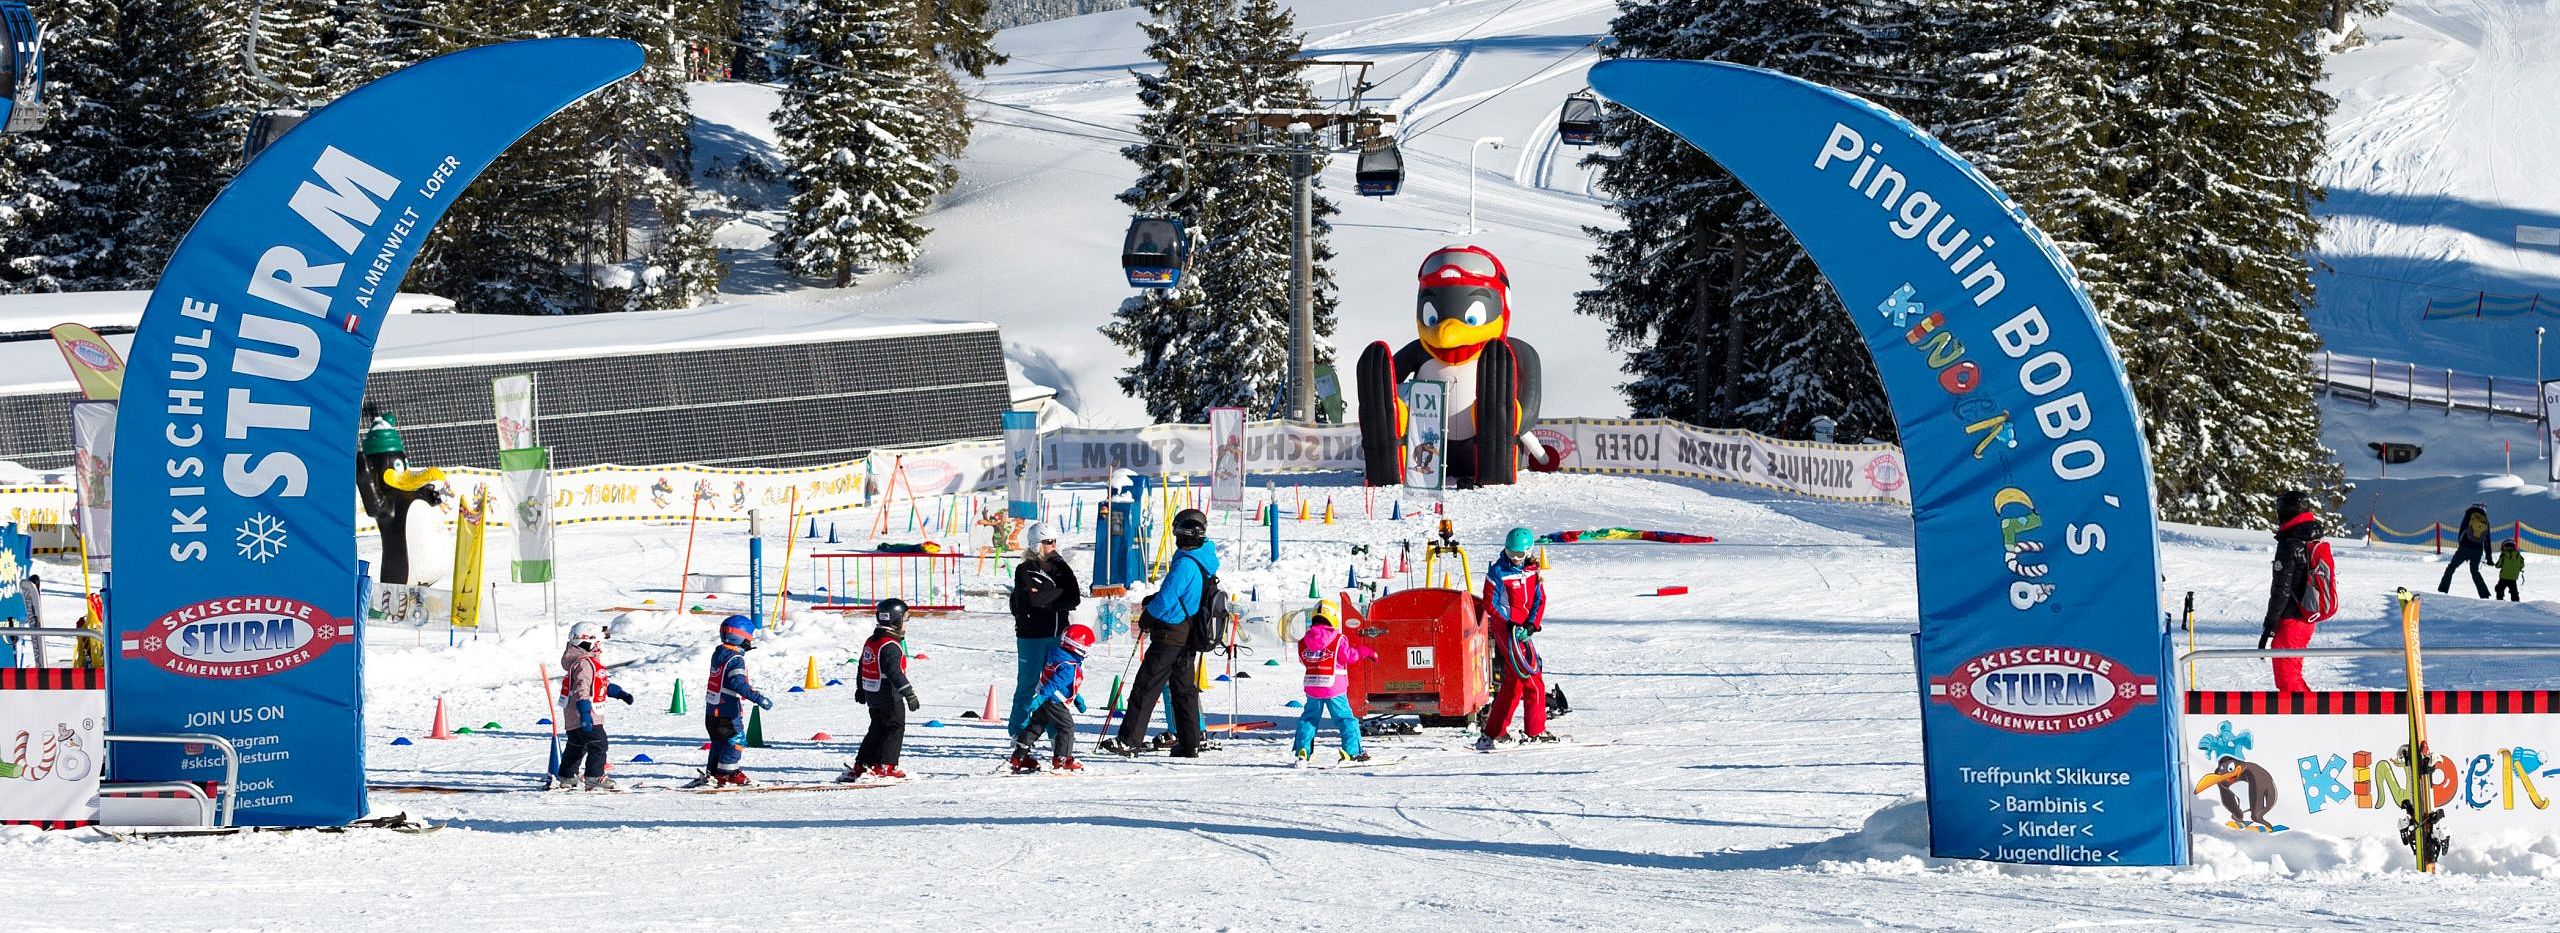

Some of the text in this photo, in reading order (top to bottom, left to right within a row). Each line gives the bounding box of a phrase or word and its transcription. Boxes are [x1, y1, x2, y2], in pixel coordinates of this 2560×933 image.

[1814, 122, 2007, 308] Pinguin
[355, 154, 461, 309] ALMENWELT LOFER
[223, 144, 402, 498] STURM
[165, 296, 219, 562] SKISCHULE
[162, 598, 313, 631] SKISCHULE
[182, 618, 296, 657] STURM
[166, 649, 311, 676] ALMENWELT LOFER
[1410, 650, 1422, 666] 10
[1966, 648, 2113, 678] SKISCHULE
[1985, 673, 2097, 706] STURM
[184, 705, 285, 728] JOIN US ON
[1971, 707, 2114, 731] ALMENWELT LOFER
[181, 750, 290, 770] #skischlesturm
[1959, 767, 2131, 787] Treffpunkt Skikurse
[2005, 795, 2088, 813] Bambinis
[2018, 821, 2077, 837] Kinder
[1995, 844, 2103, 864] Jugendliche
